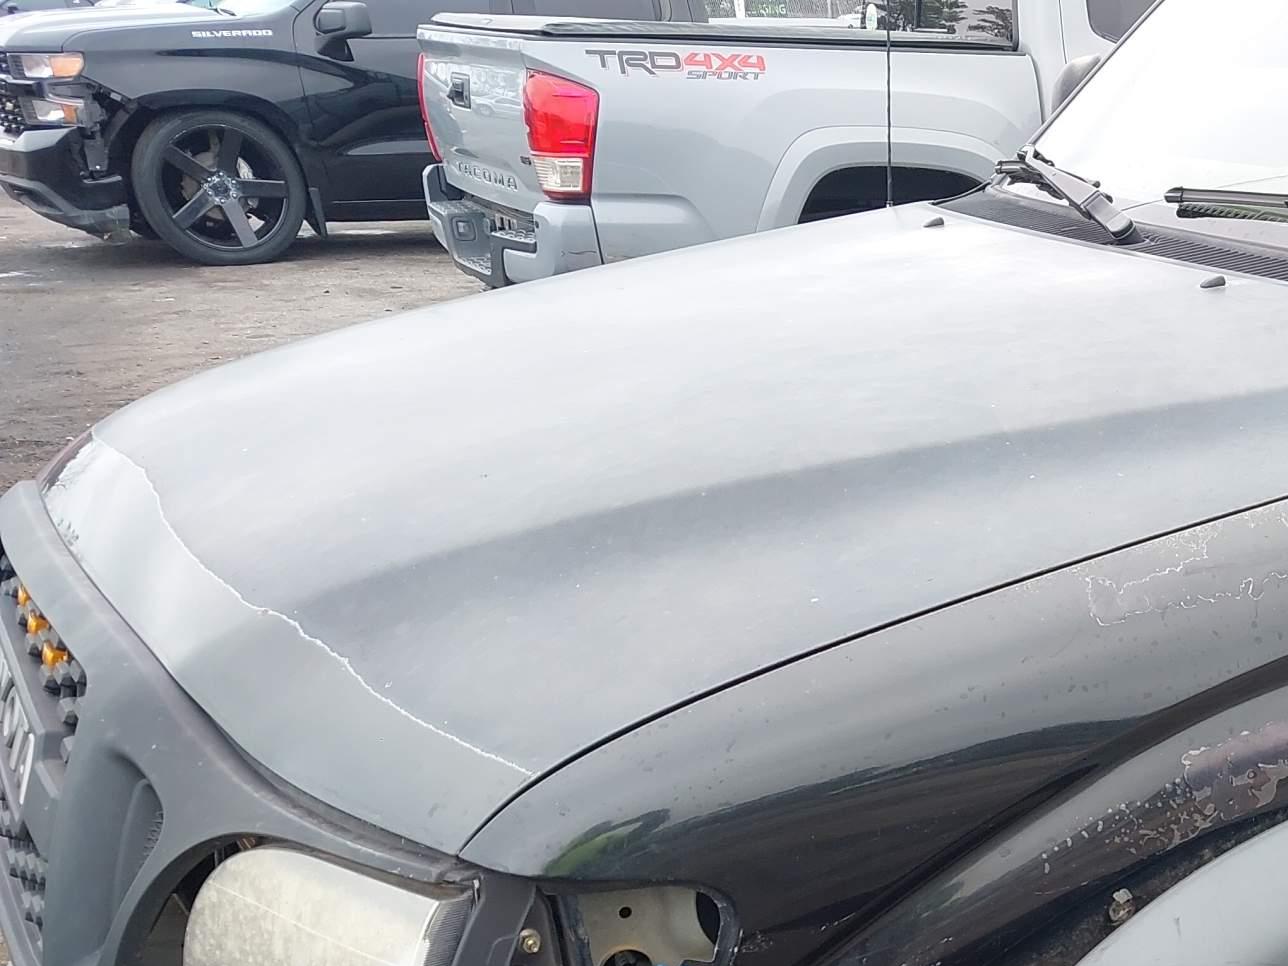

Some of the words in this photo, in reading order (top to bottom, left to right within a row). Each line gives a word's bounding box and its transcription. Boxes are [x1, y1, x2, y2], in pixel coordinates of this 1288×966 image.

[191, 29, 273, 38] SILVERADO
[686, 70, 765, 80] SPORT
[456, 160, 519, 192] TACOMA
